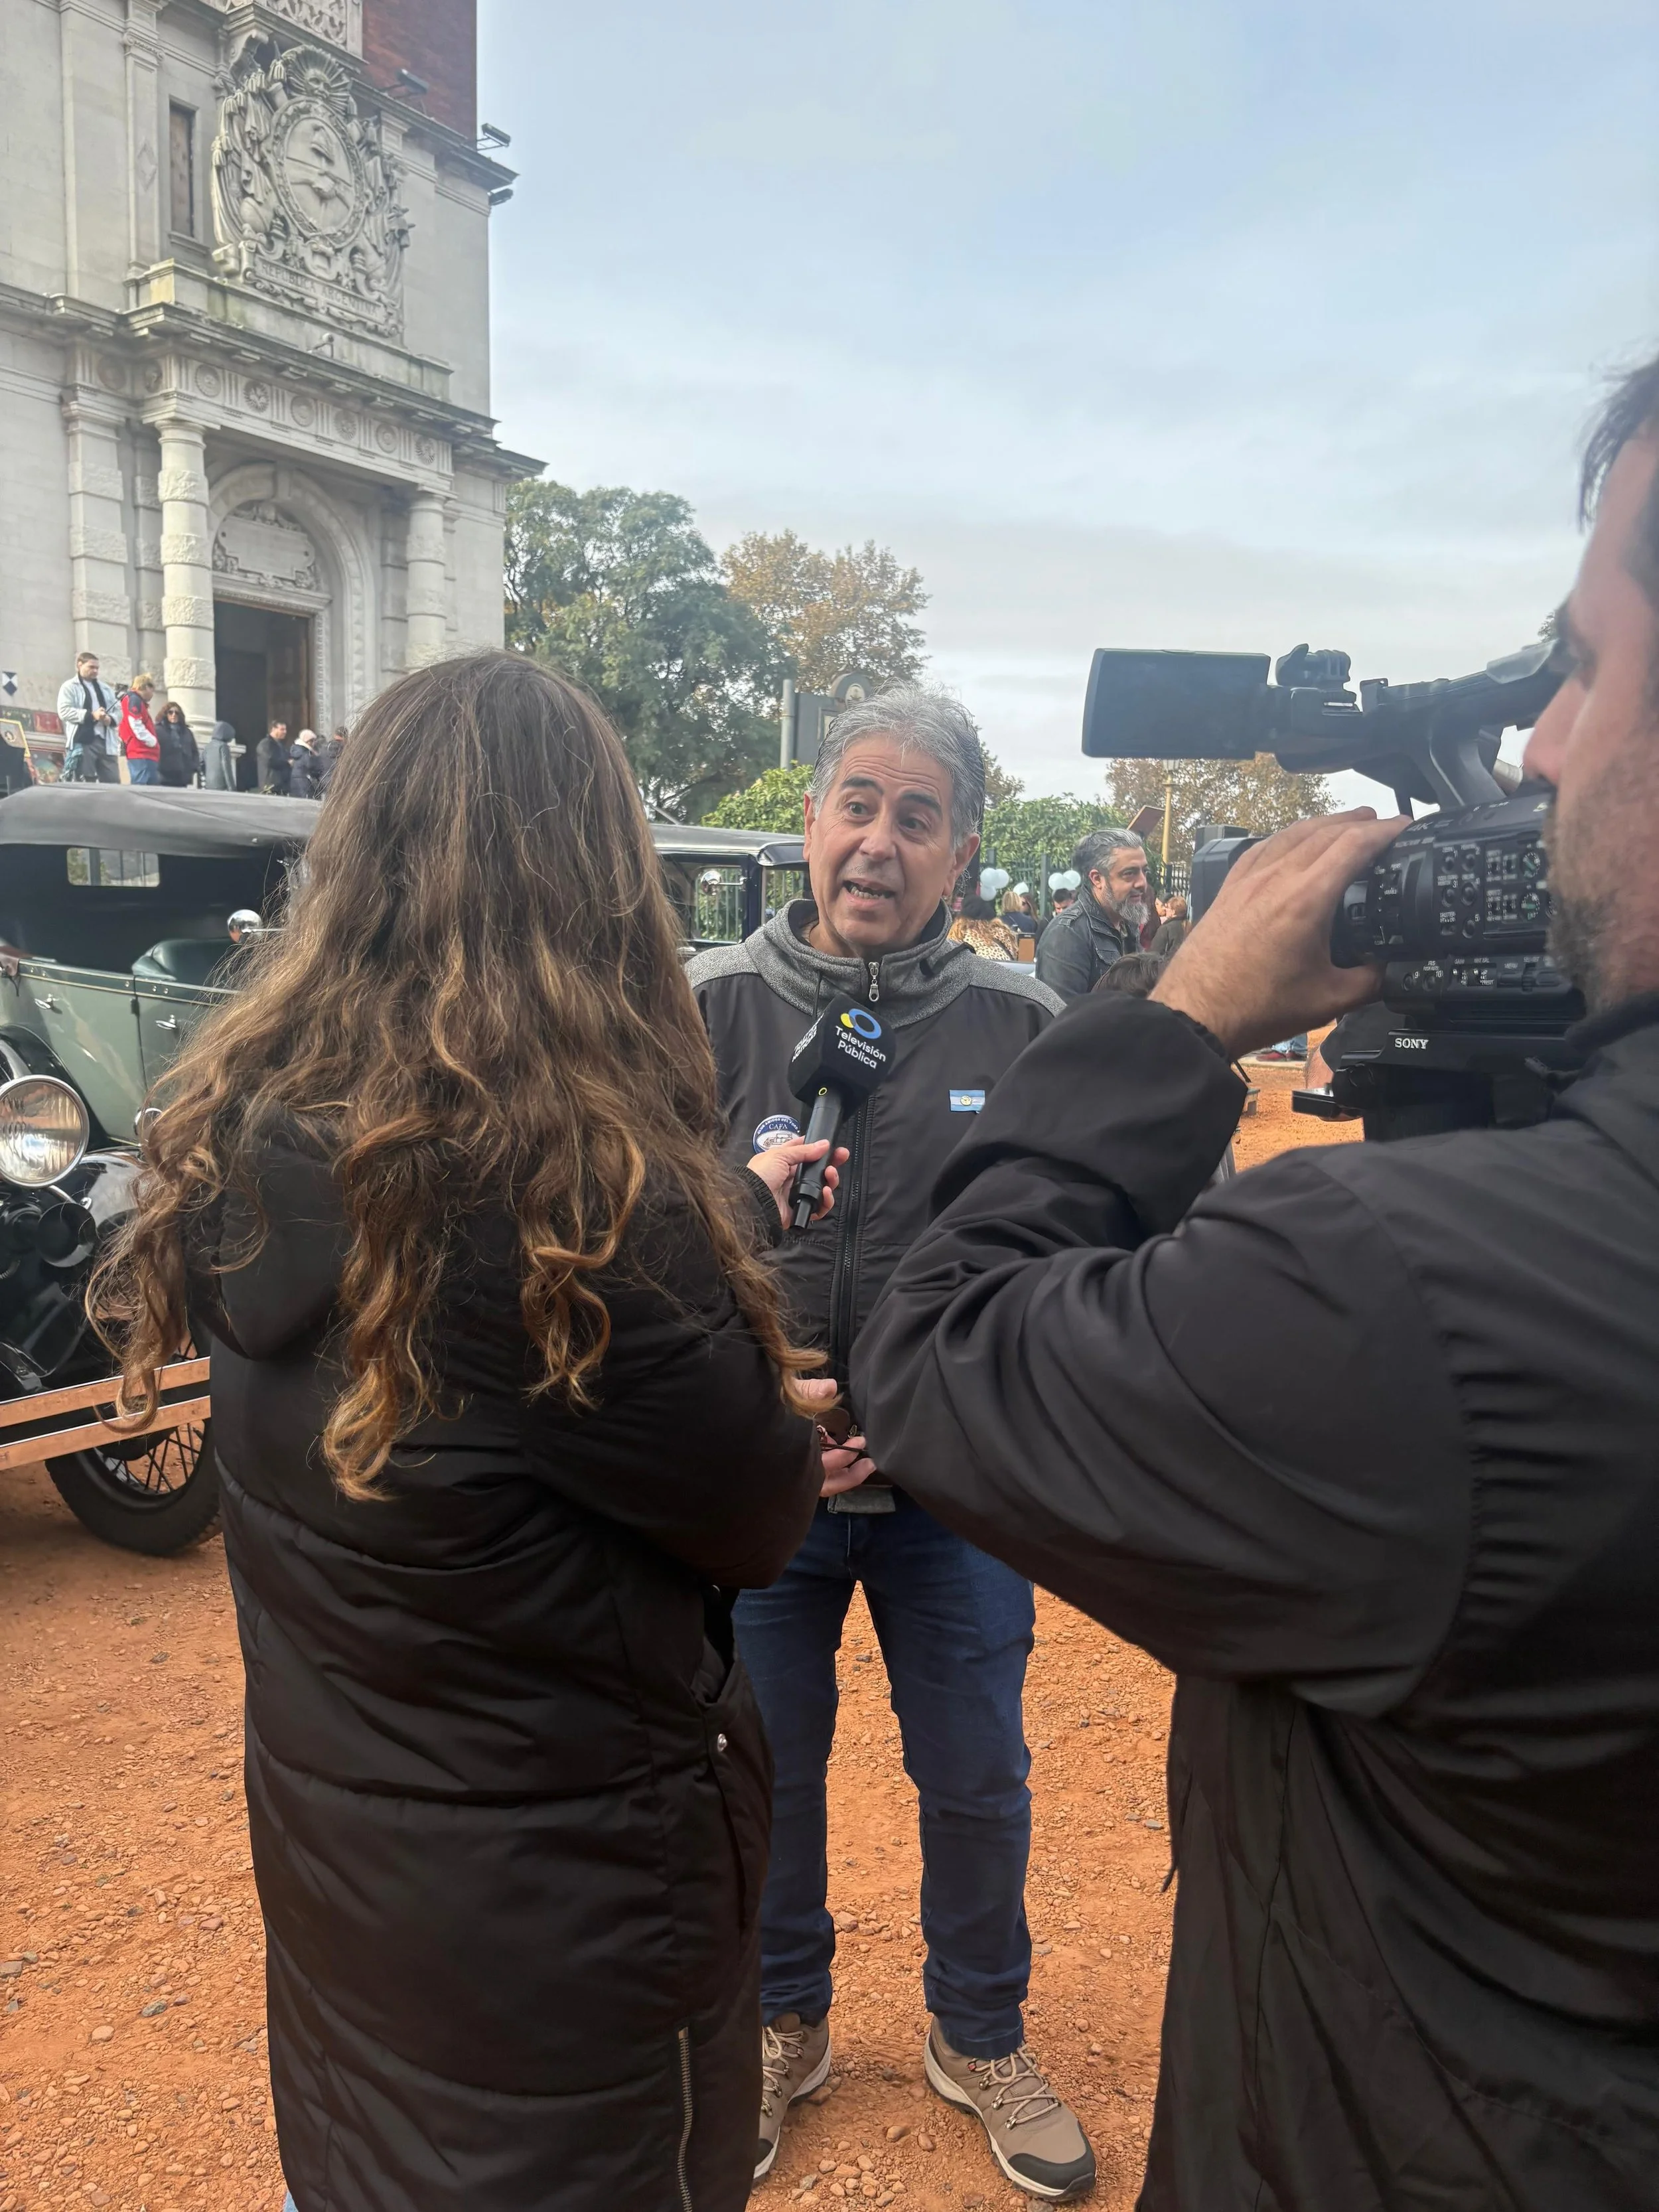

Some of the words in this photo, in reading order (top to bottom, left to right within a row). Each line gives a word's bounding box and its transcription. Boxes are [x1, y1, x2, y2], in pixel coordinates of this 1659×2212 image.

[321, 285, 380, 318] ARGENTINA
[835, 1025, 887, 1062] Televisión
[837, 1040, 877, 1069] Pública
[1395, 1038, 1429, 1049] SONY
